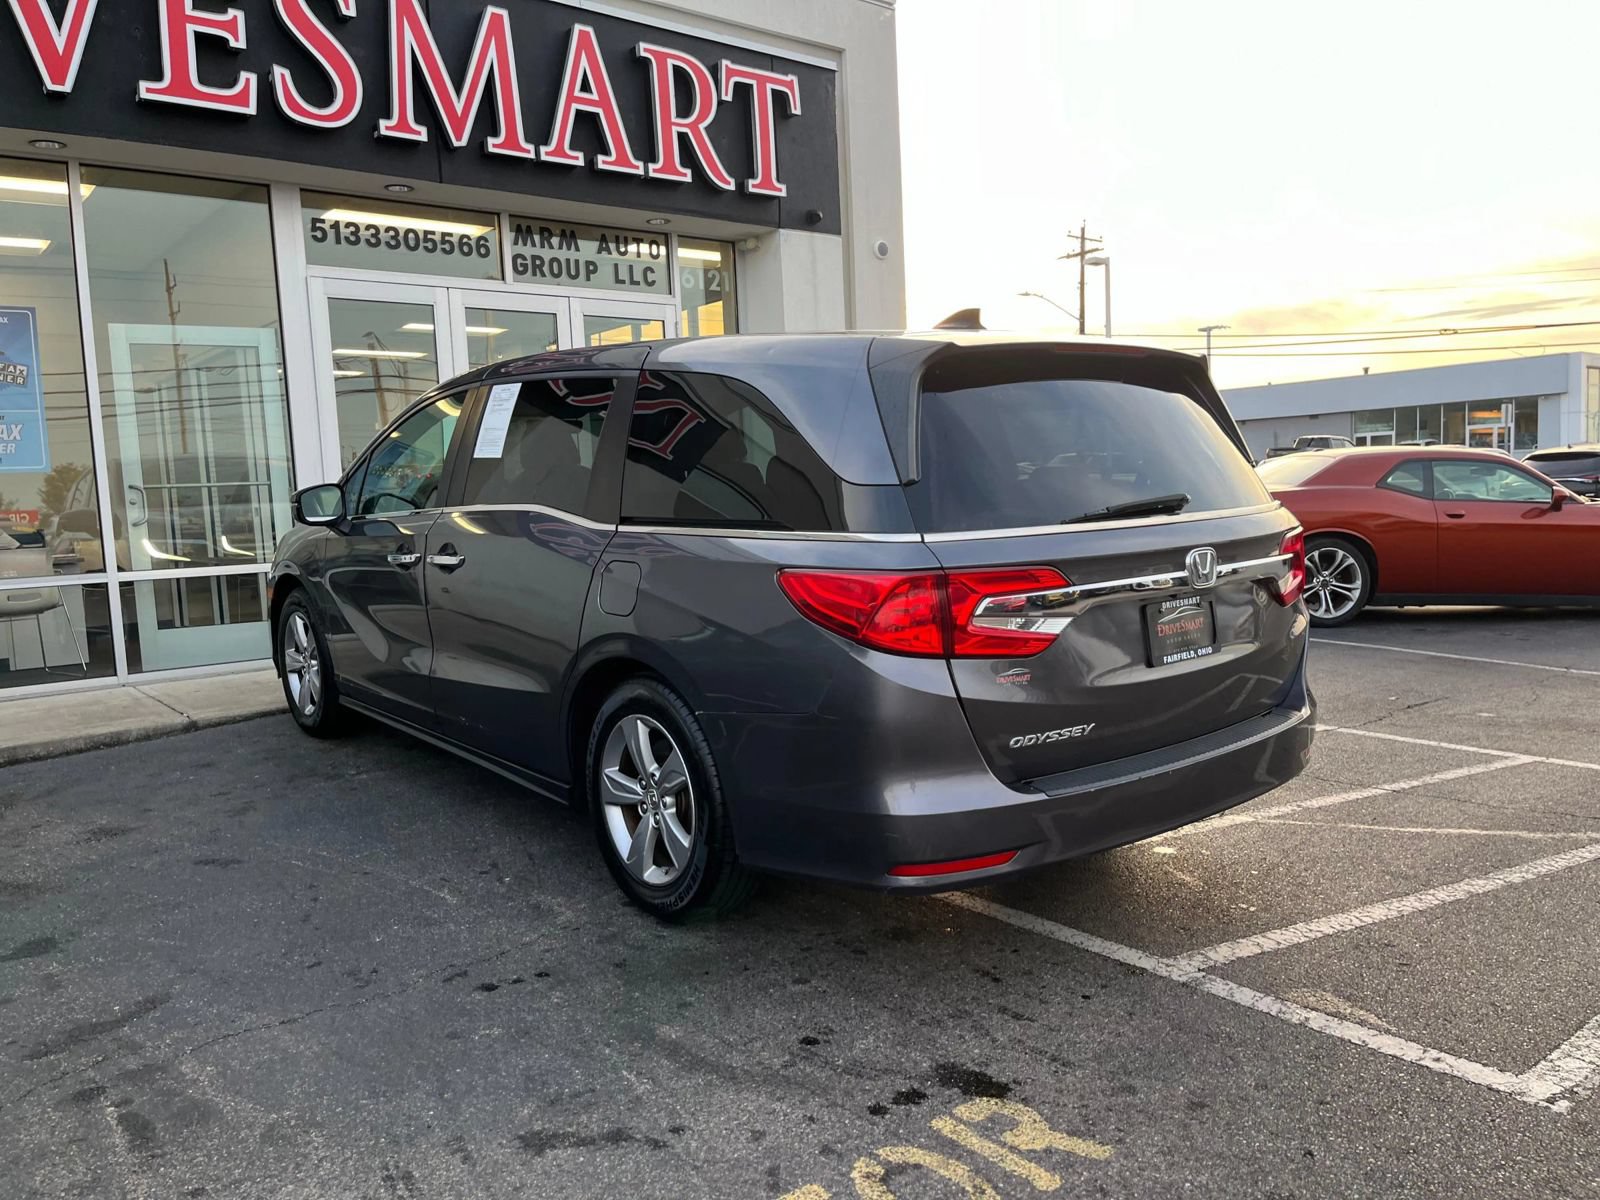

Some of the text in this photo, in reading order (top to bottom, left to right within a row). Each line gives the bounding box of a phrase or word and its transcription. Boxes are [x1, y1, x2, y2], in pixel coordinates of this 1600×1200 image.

[310, 217, 492, 259] 5133305566
[513, 223, 661, 260] MRM AUTO
[512, 253, 658, 287] GROUP LLC
[1162, 596, 1201, 609] DRIVESMART
[1163, 650, 1197, 664] FAIRFIELD,
[1198, 646, 1213, 656] OHIO
[1009, 723, 1096, 748] ODYSSEY
